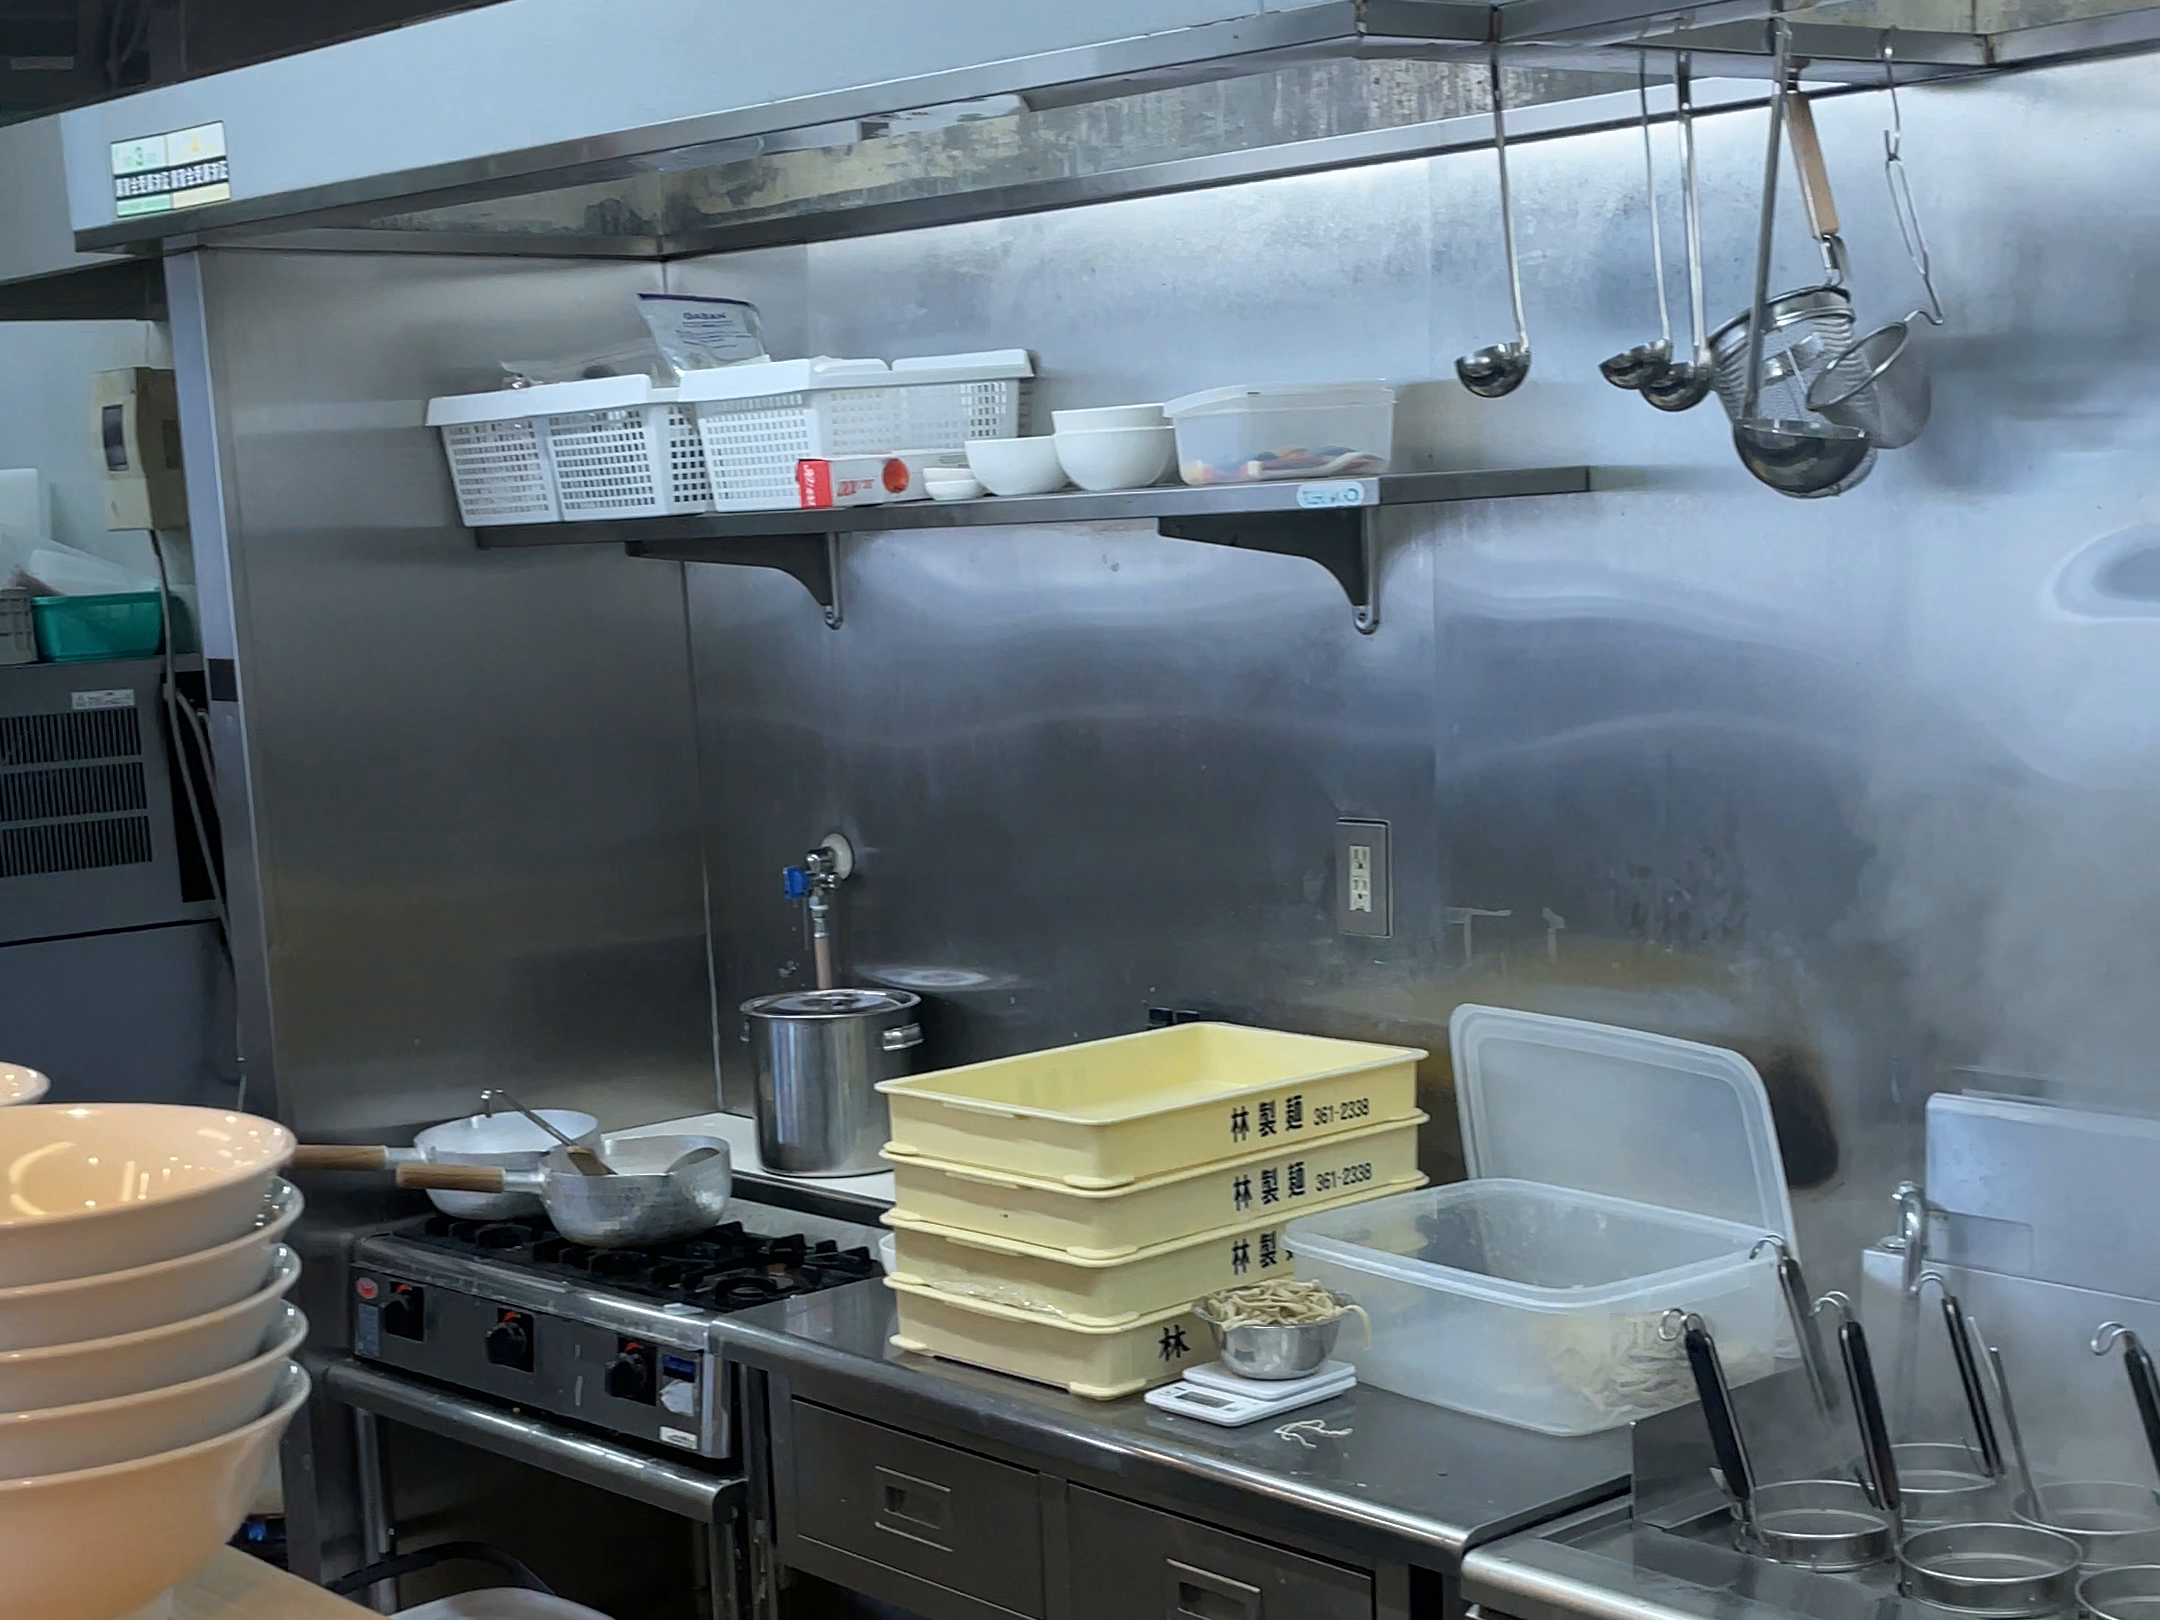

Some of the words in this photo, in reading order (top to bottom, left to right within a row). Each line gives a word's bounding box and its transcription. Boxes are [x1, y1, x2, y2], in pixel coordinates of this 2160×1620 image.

[1313, 1098, 1370, 1126] 361-2338
[1315, 1162, 1373, 1192] 361-2338
[1231, 1230, 1293, 1276] 林製
[1158, 1324, 1191, 1362] 林
